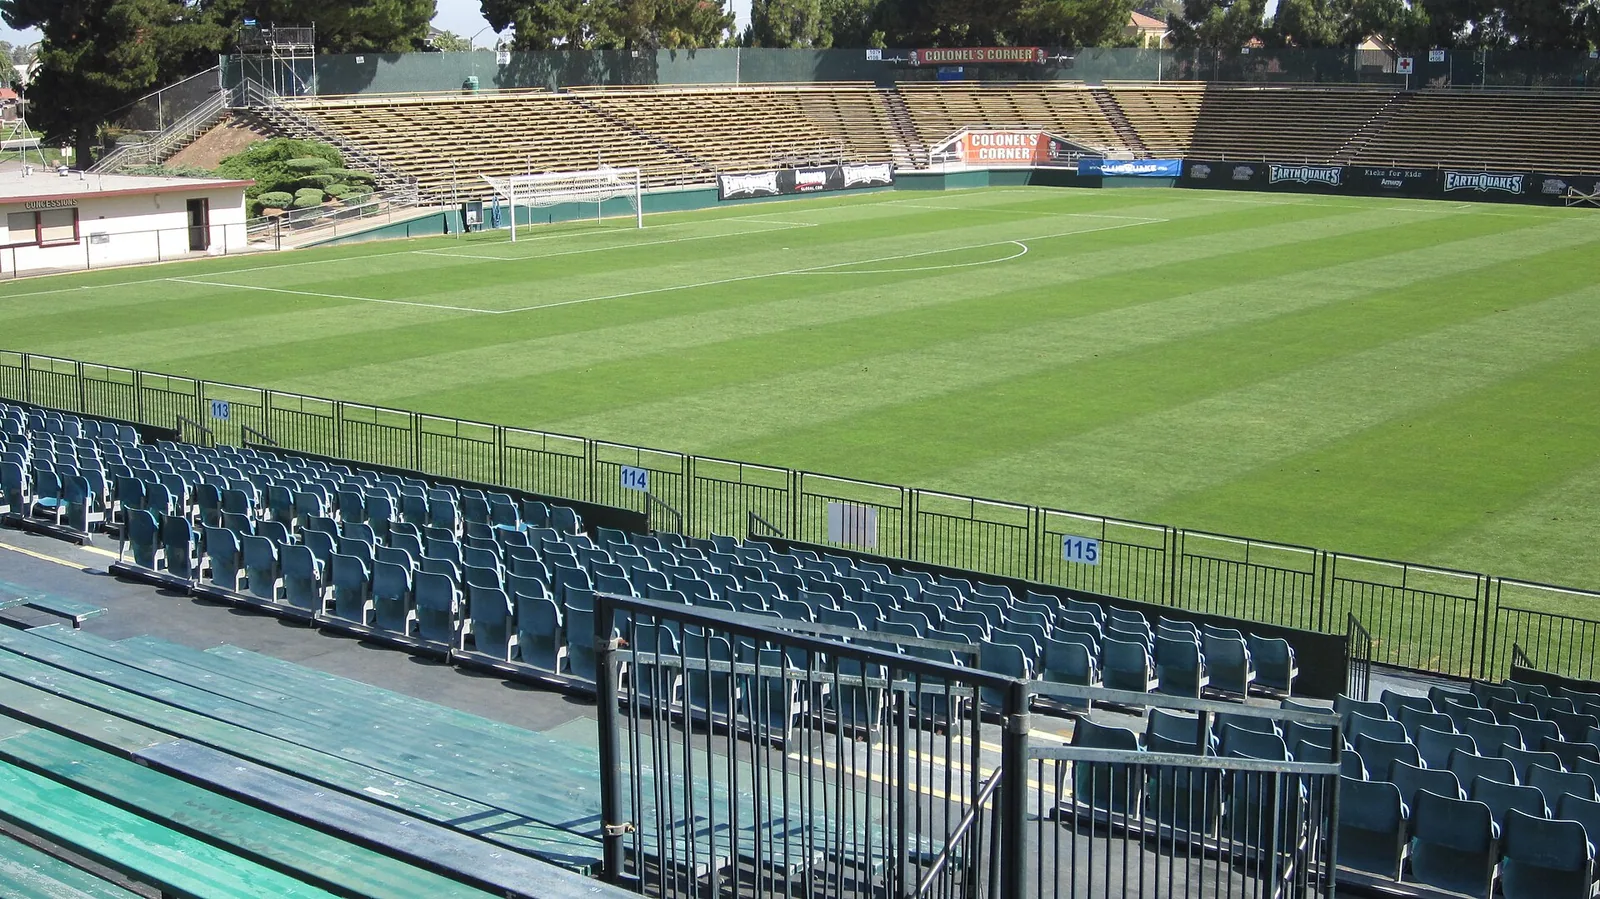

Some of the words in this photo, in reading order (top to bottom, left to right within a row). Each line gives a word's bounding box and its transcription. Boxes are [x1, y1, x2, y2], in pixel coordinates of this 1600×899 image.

[925, 50, 984, 61] COLONEL'S
[987, 49, 1032, 60] CORNER
[972, 134, 1037, 146] COLONEL'S
[980, 147, 1030, 159] CORNER
[1271, 166, 1339, 185] EARTHQUAKES
[1381, 178, 1403, 187] Amway
[1446, 172, 1522, 192] EARTHQUAKES
[25, 198, 78, 210] CONCESSIONS
[212, 402, 228, 418] 113
[622, 469, 646, 488] 114
[1064, 539, 1097, 561] 115
